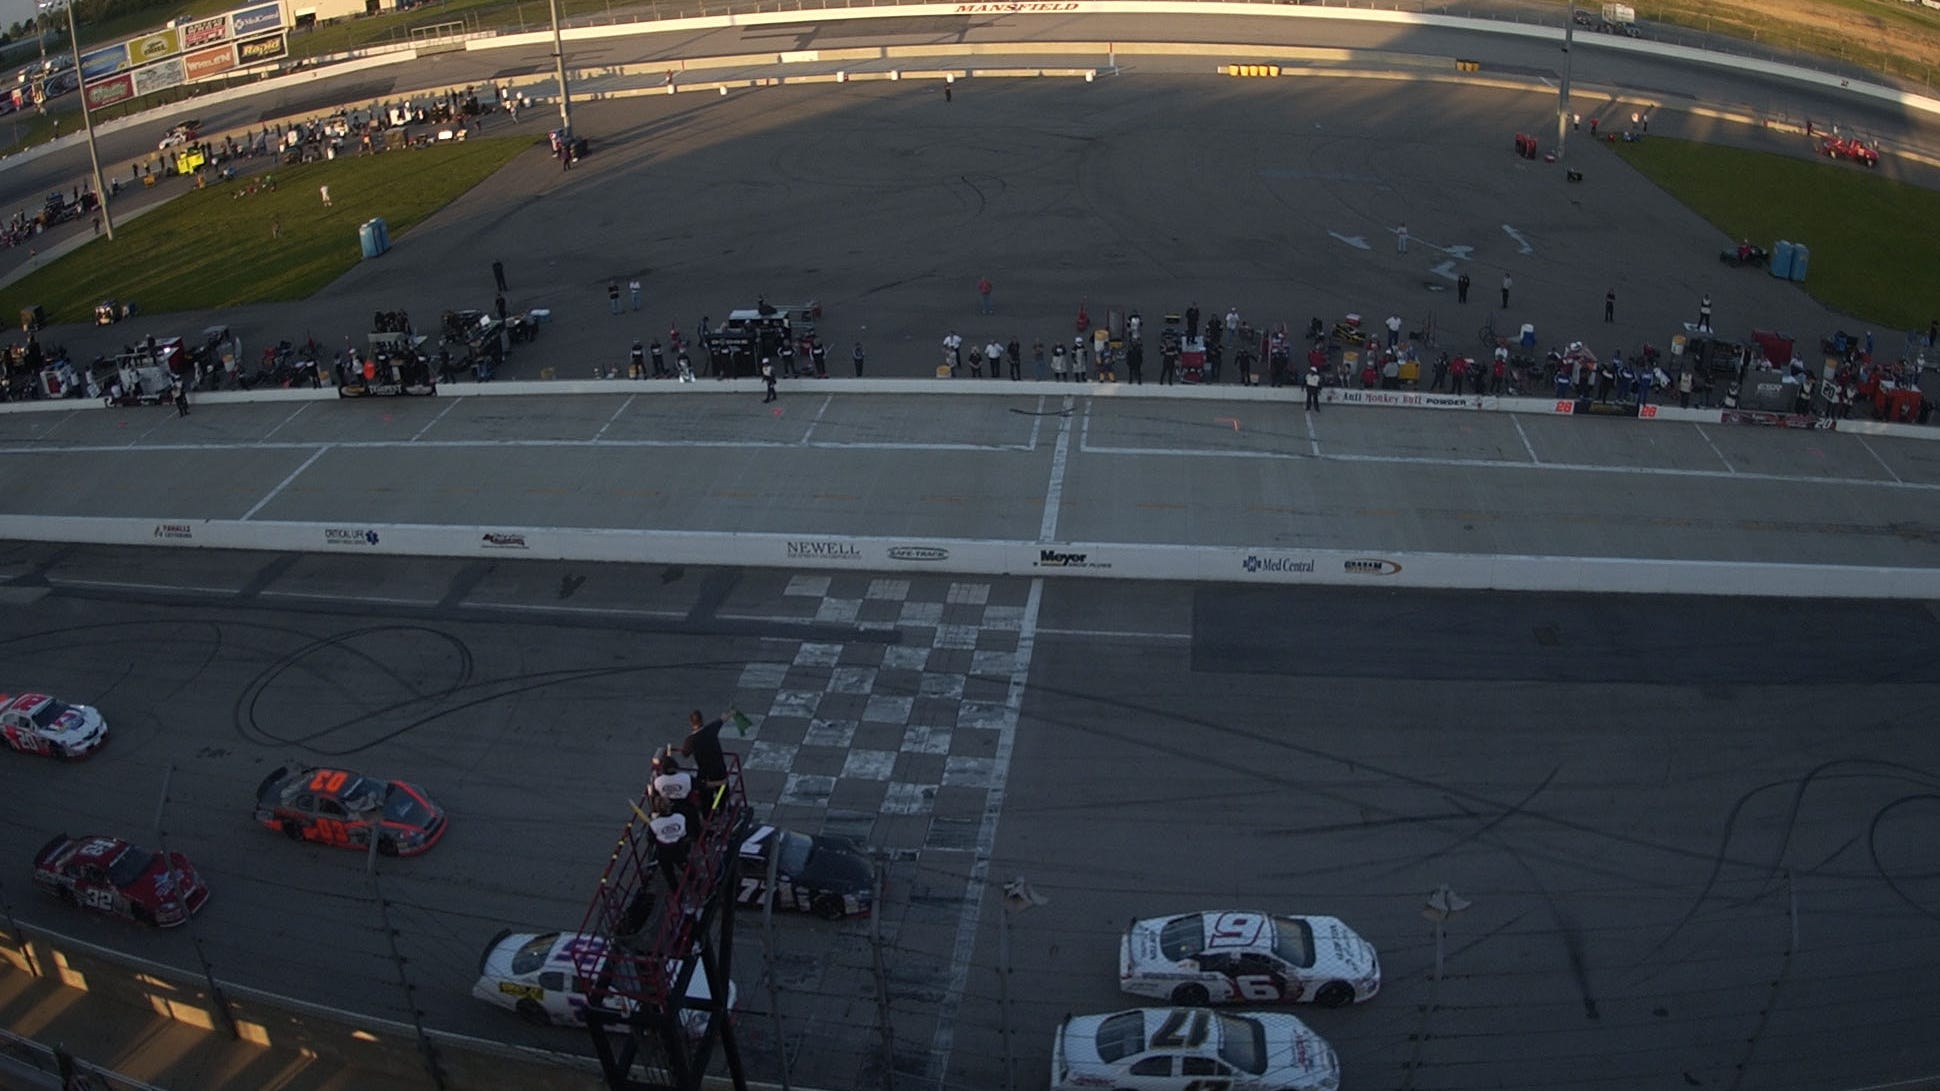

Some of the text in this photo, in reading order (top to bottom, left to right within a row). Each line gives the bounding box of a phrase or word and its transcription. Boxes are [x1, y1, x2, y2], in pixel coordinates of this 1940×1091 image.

[956, 3, 1079, 12] MANSFIELD
[787, 541, 860, 554] NEWELL
[1040, 549, 1087, 566] Meyer
[86, 889, 113, 910] 32
[1236, 974, 1280, 1001] 6
